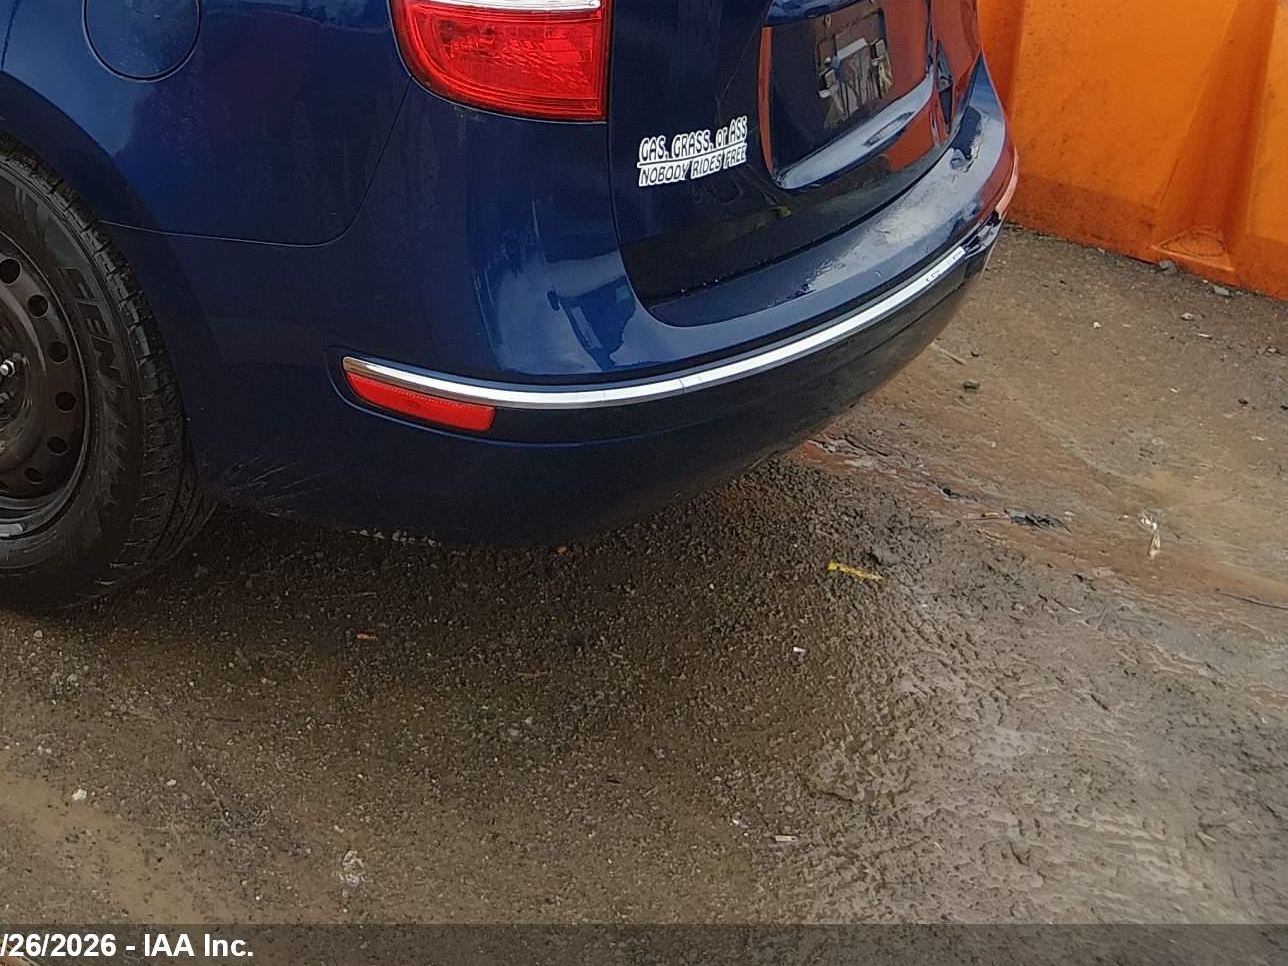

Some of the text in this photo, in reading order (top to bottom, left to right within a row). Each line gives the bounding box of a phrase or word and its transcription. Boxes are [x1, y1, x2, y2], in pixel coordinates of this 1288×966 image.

[729, 116, 747, 143] ASS
[640, 145, 747, 185] NOBODY RIDES FREE
